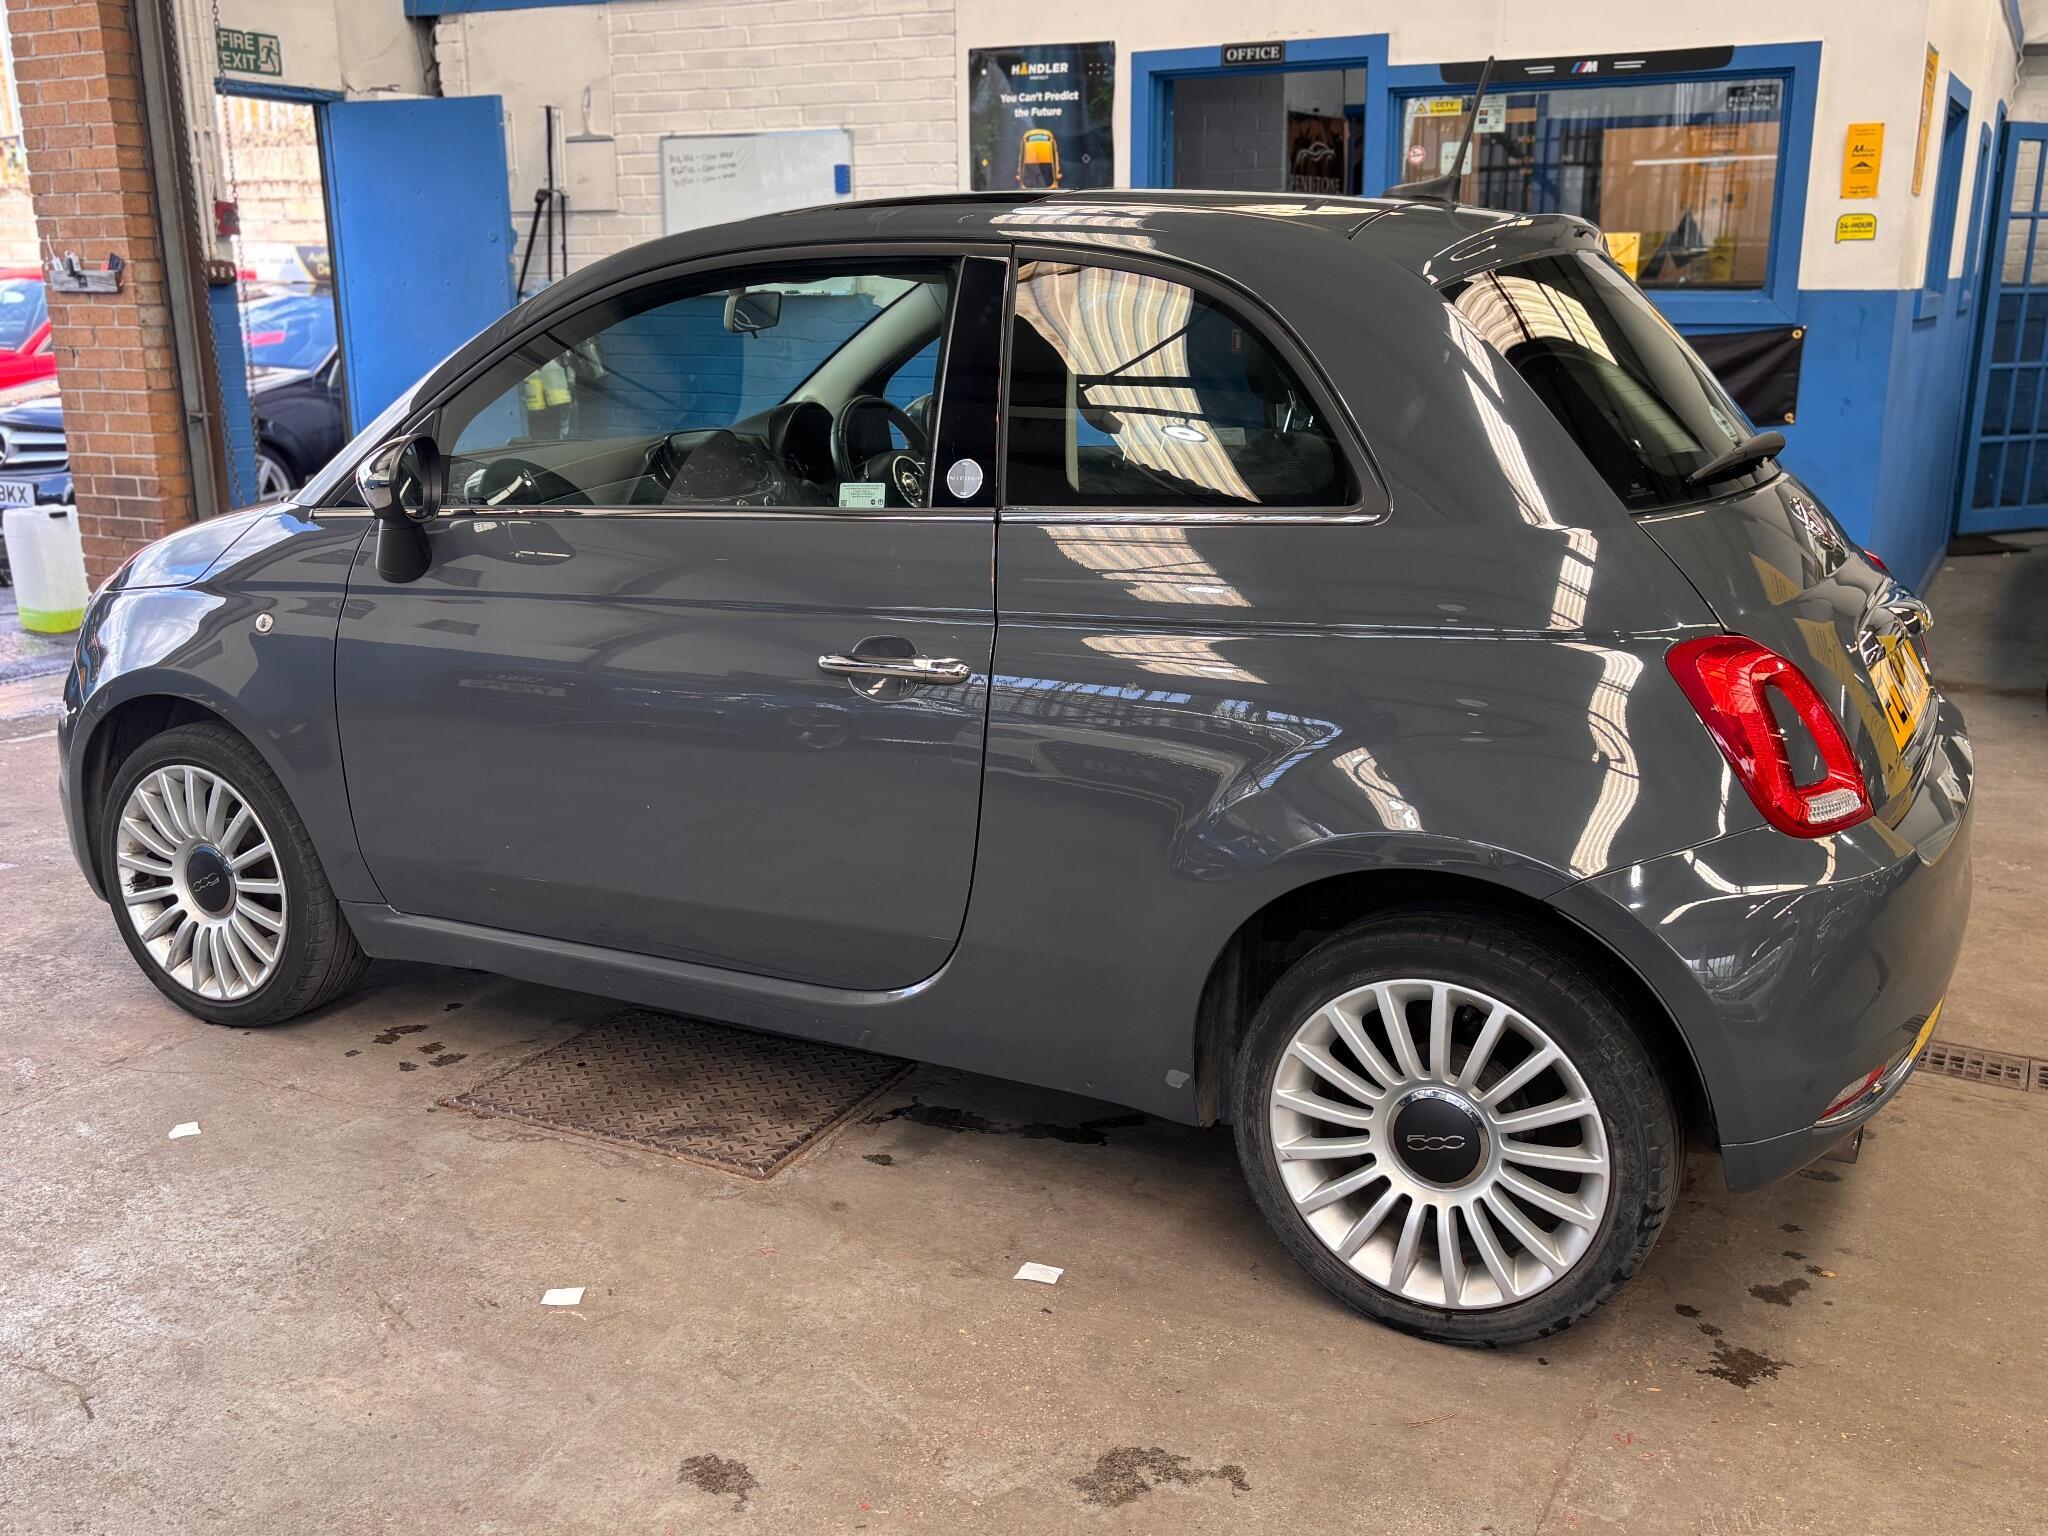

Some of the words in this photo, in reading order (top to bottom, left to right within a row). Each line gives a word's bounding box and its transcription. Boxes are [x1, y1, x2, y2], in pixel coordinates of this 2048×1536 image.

[220, 32, 255, 51] FIRE
[222, 51, 256, 70] EXIT
[1226, 46, 1280, 61] OFFICE
[1011, 62, 1069, 76] HANDLER
[1000, 93, 1018, 104] You
[1018, 92, 1043, 103] Can't
[1044, 90, 1079, 102] Predict
[1014, 107, 1030, 118] the
[1030, 106, 1062, 117] Future
[1406, 1134, 1466, 1151] 500
